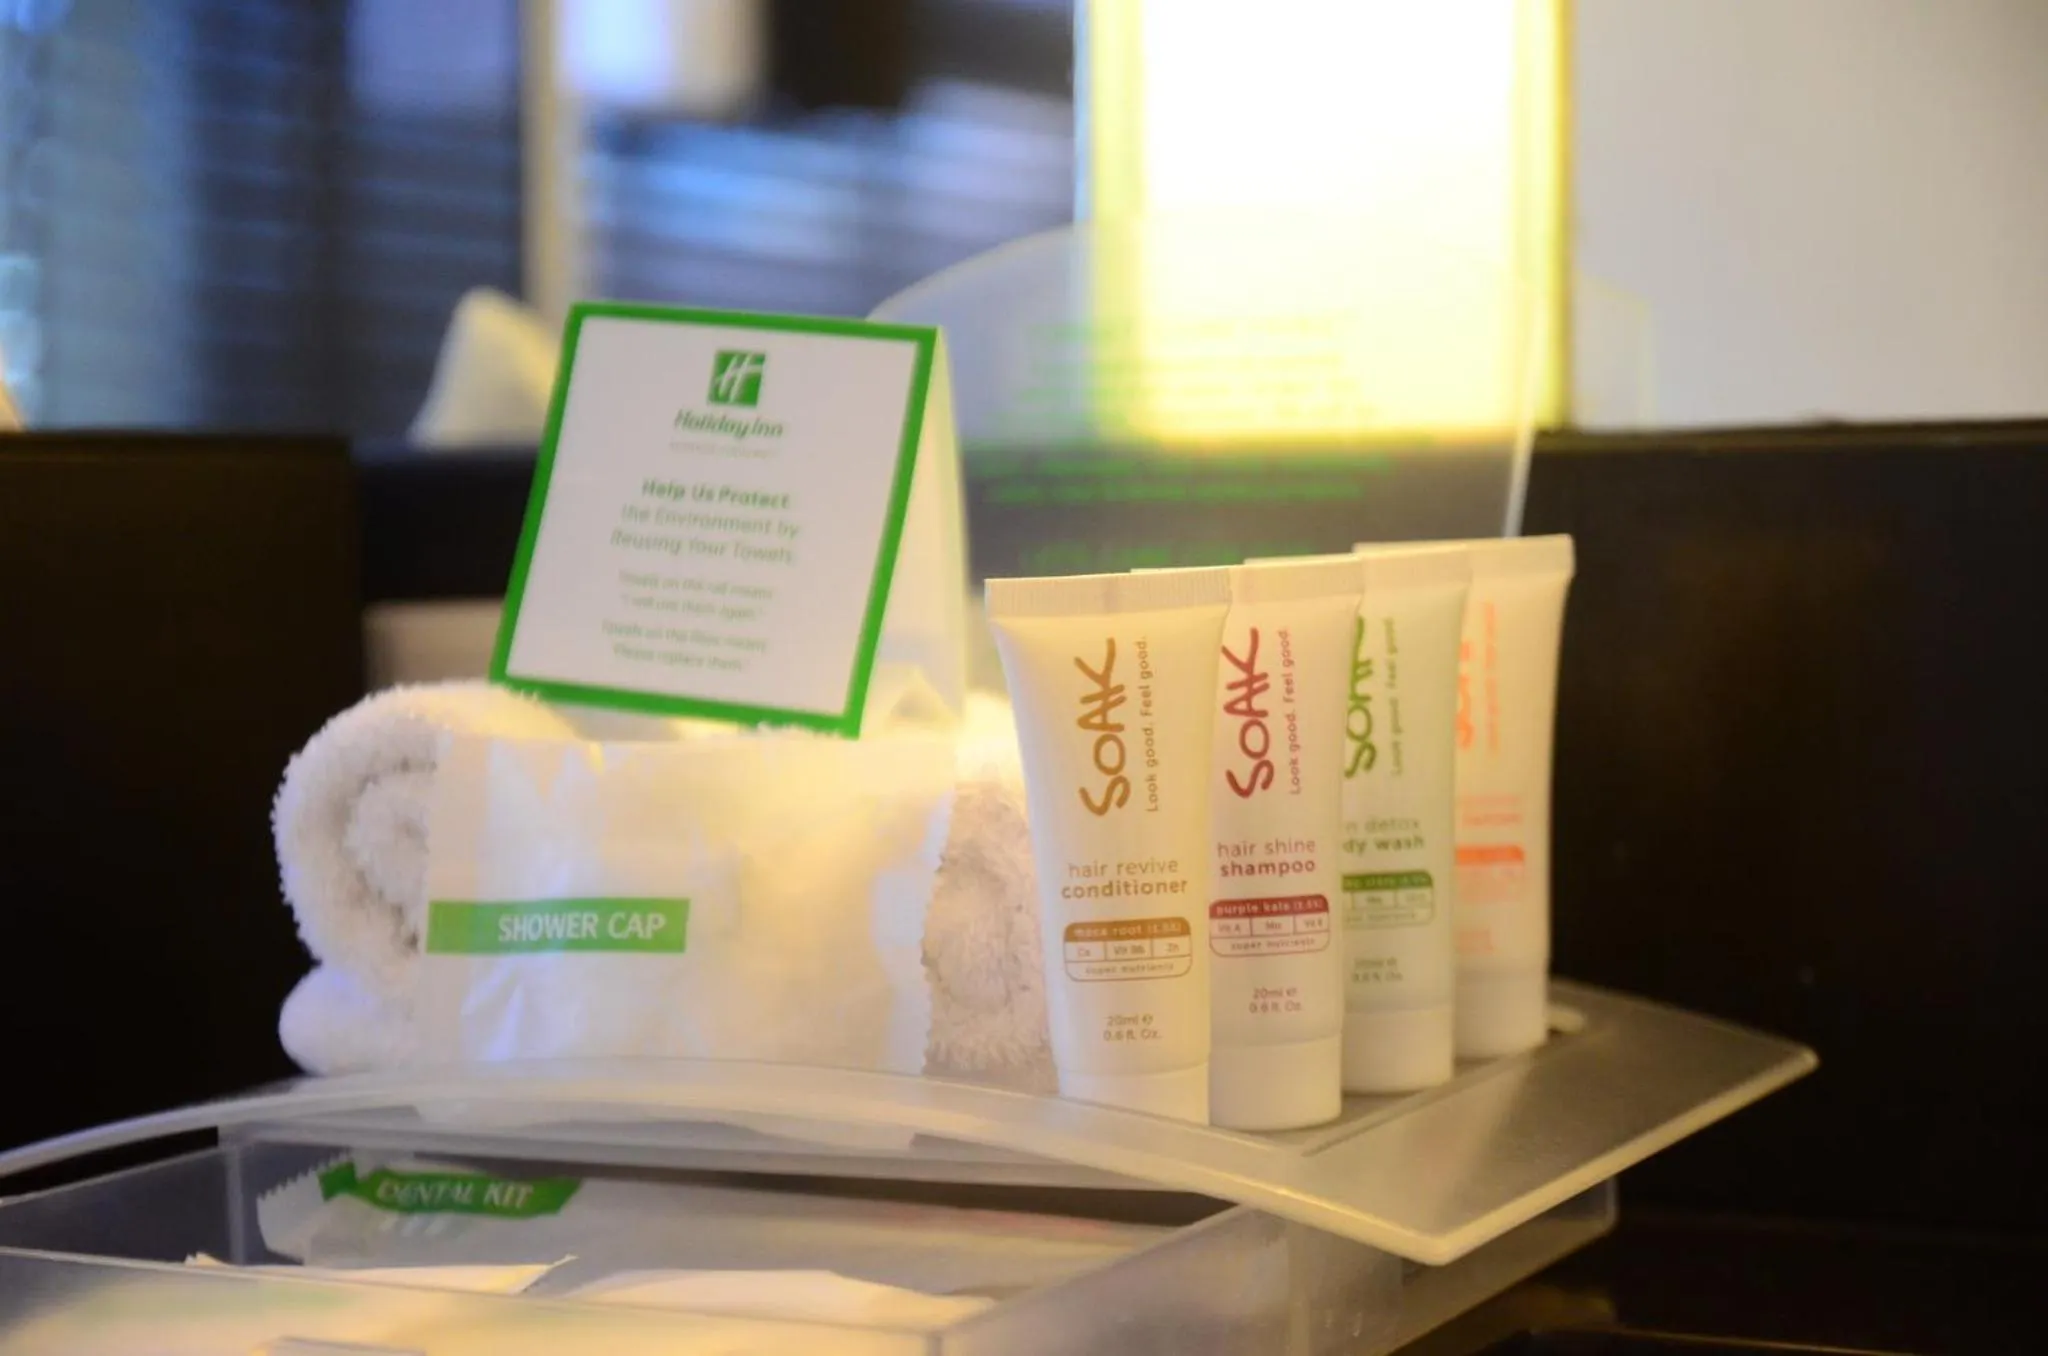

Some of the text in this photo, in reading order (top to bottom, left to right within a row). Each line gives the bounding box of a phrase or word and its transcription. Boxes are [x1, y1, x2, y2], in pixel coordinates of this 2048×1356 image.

[674, 408, 749, 439] Holiday
[642, 479, 790, 508] Help Us Protect
[622, 503, 798, 539] the Environment by
[610, 527, 682, 555] Reusing
[1138, 685, 1152, 717] Feel
[1281, 673, 1294, 703] Feel
[1074, 637, 1131, 816] SOAK
[1221, 627, 1274, 798] SOAK
[1290, 758, 1301, 795] Look
[1145, 774, 1159, 812] Look
[1217, 837, 1316, 858] hair shine
[1374, 836, 1425, 850] wash
[1069, 857, 1178, 878] hair revive
[1220, 860, 1316, 877] shampoo
[1061, 879, 1188, 899] conditioner
[498, 912, 667, 941] SHOWER CAP
[1107, 1014, 1139, 1027] 20ml
[376, 1179, 534, 1208] DENTAL KIT
